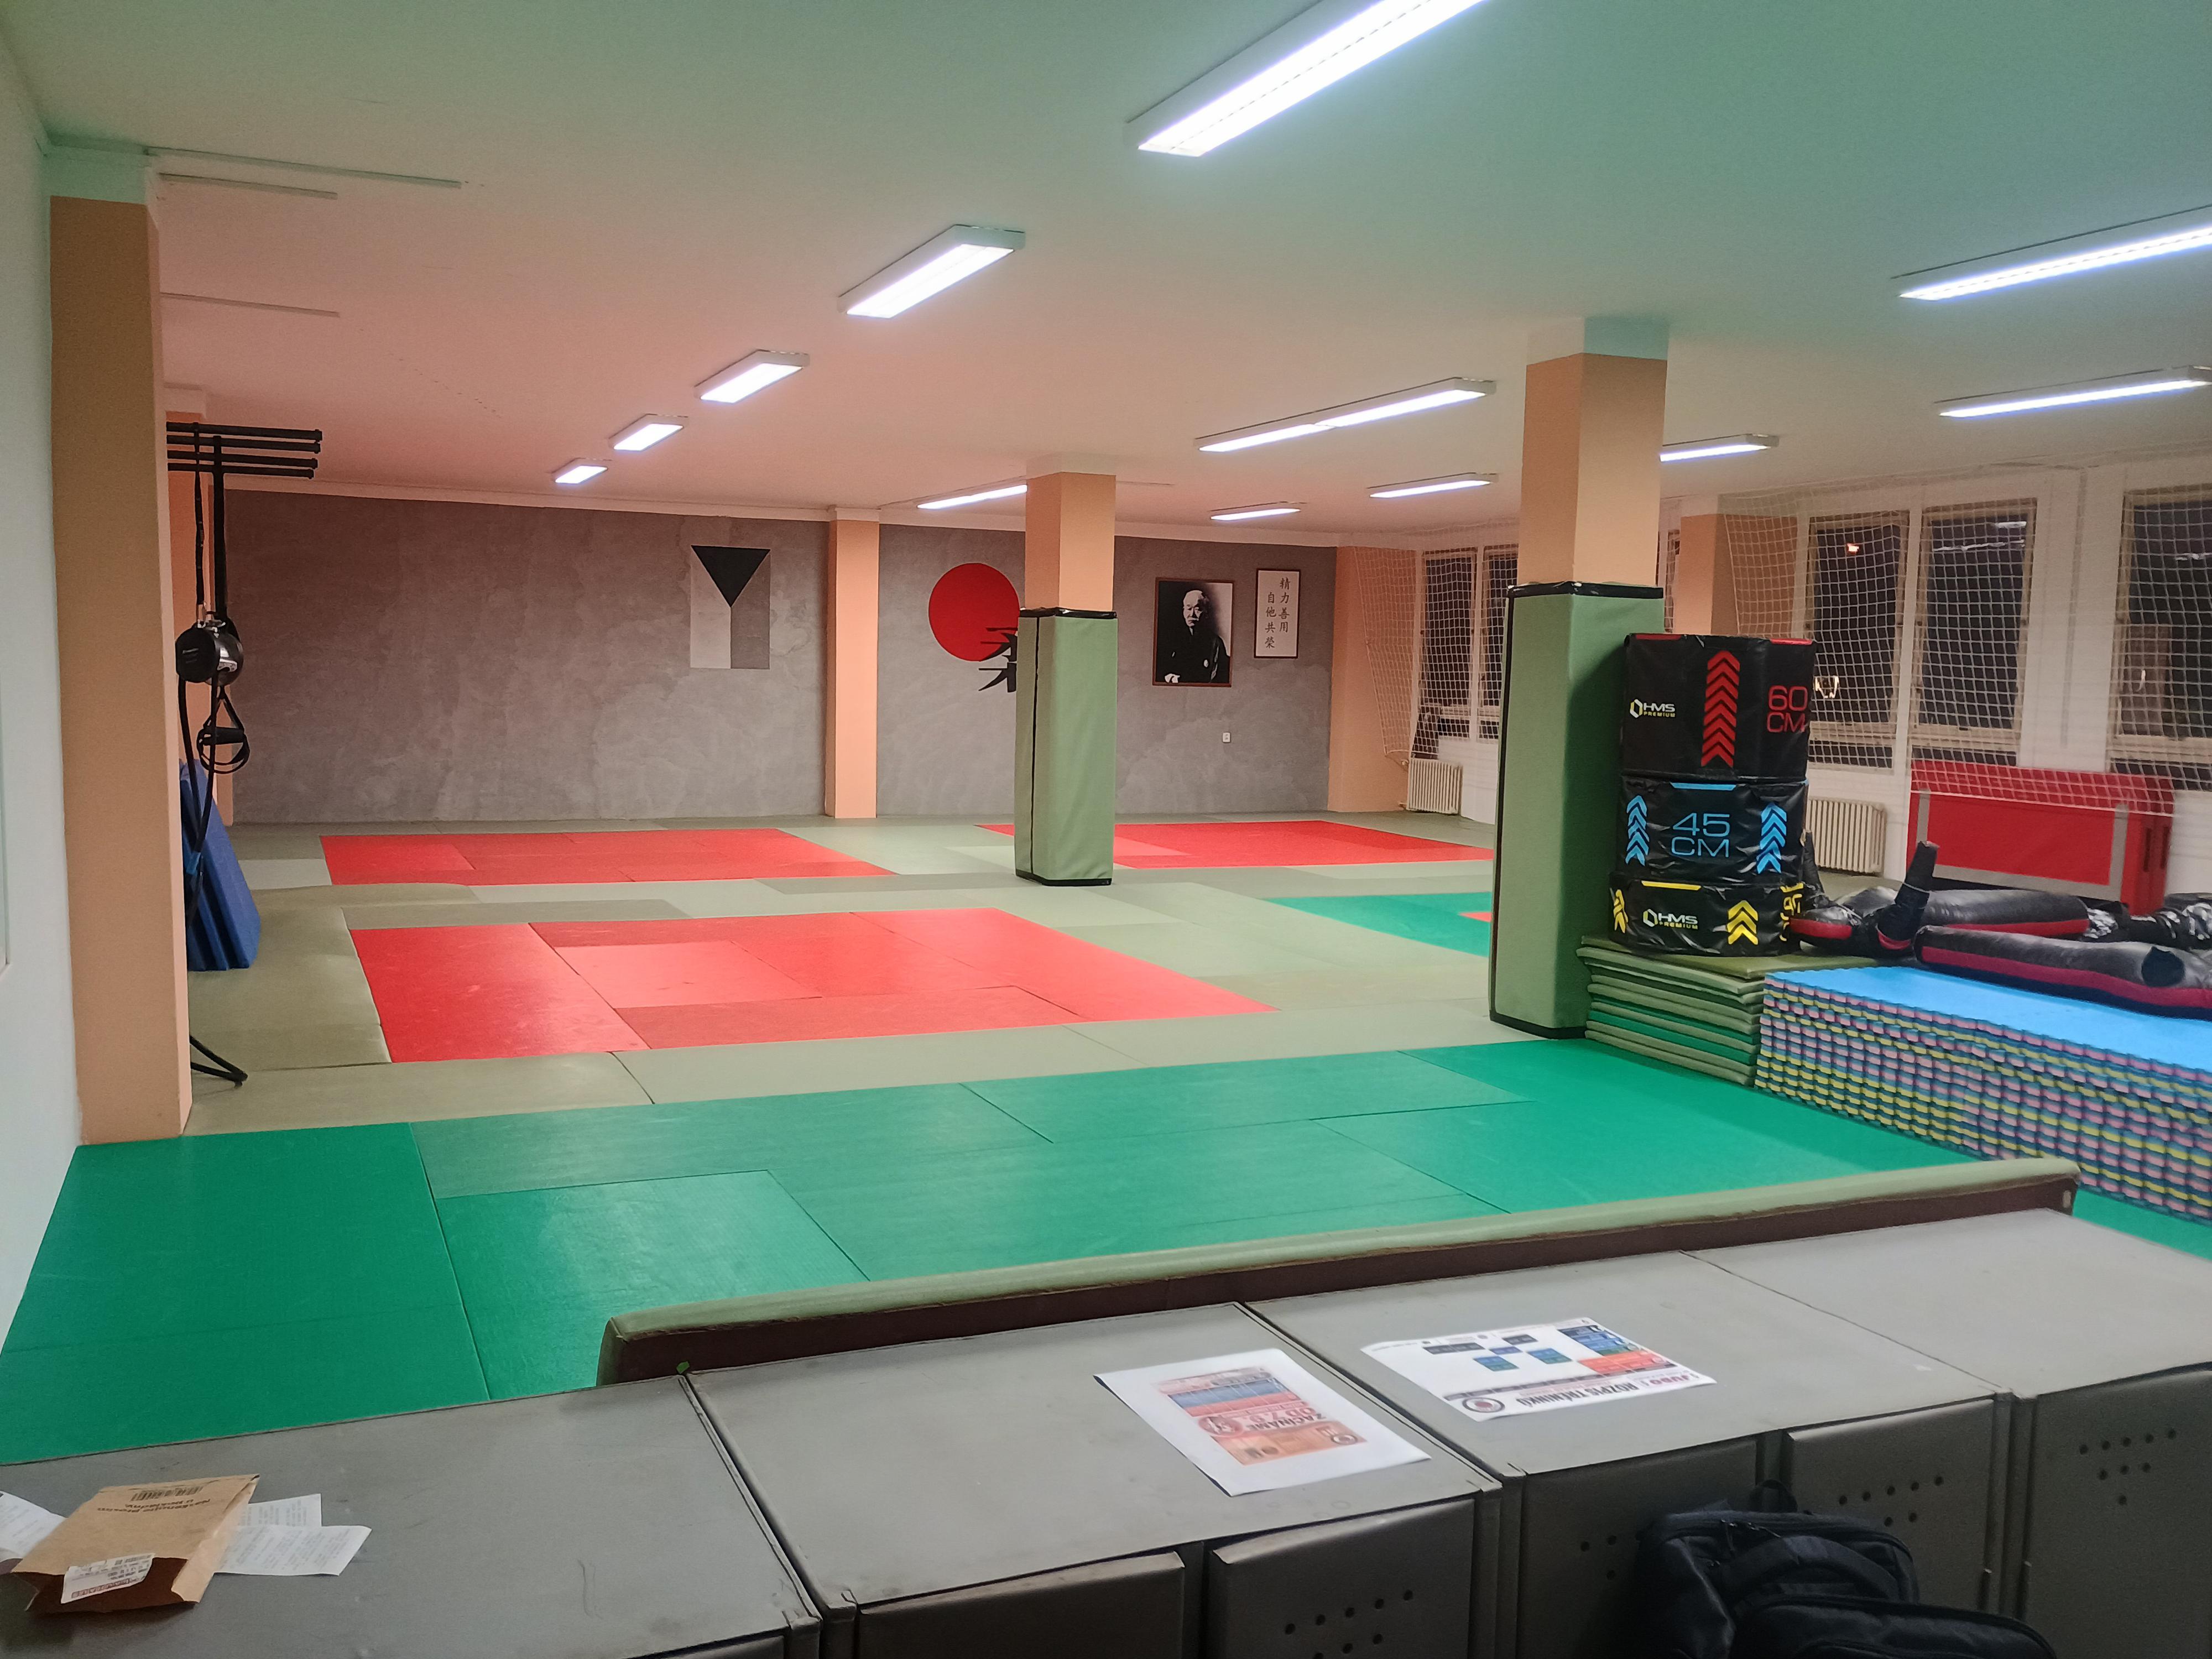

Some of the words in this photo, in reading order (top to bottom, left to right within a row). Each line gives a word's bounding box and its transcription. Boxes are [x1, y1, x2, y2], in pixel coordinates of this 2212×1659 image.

[1279, 577, 1291, 633] 精力善用
[1644, 702, 1676, 712] HMS
[1768, 685, 1808, 712] 60
[1766, 712, 1806, 733] CM
[1672, 812, 1730, 837] 45
[1671, 836, 1730, 858] CM
[1658, 913, 1698, 925] HMS
[1659, 921, 1698, 930] PREMIUM
[1585, 1382, 1640, 1396] ROZPIS
